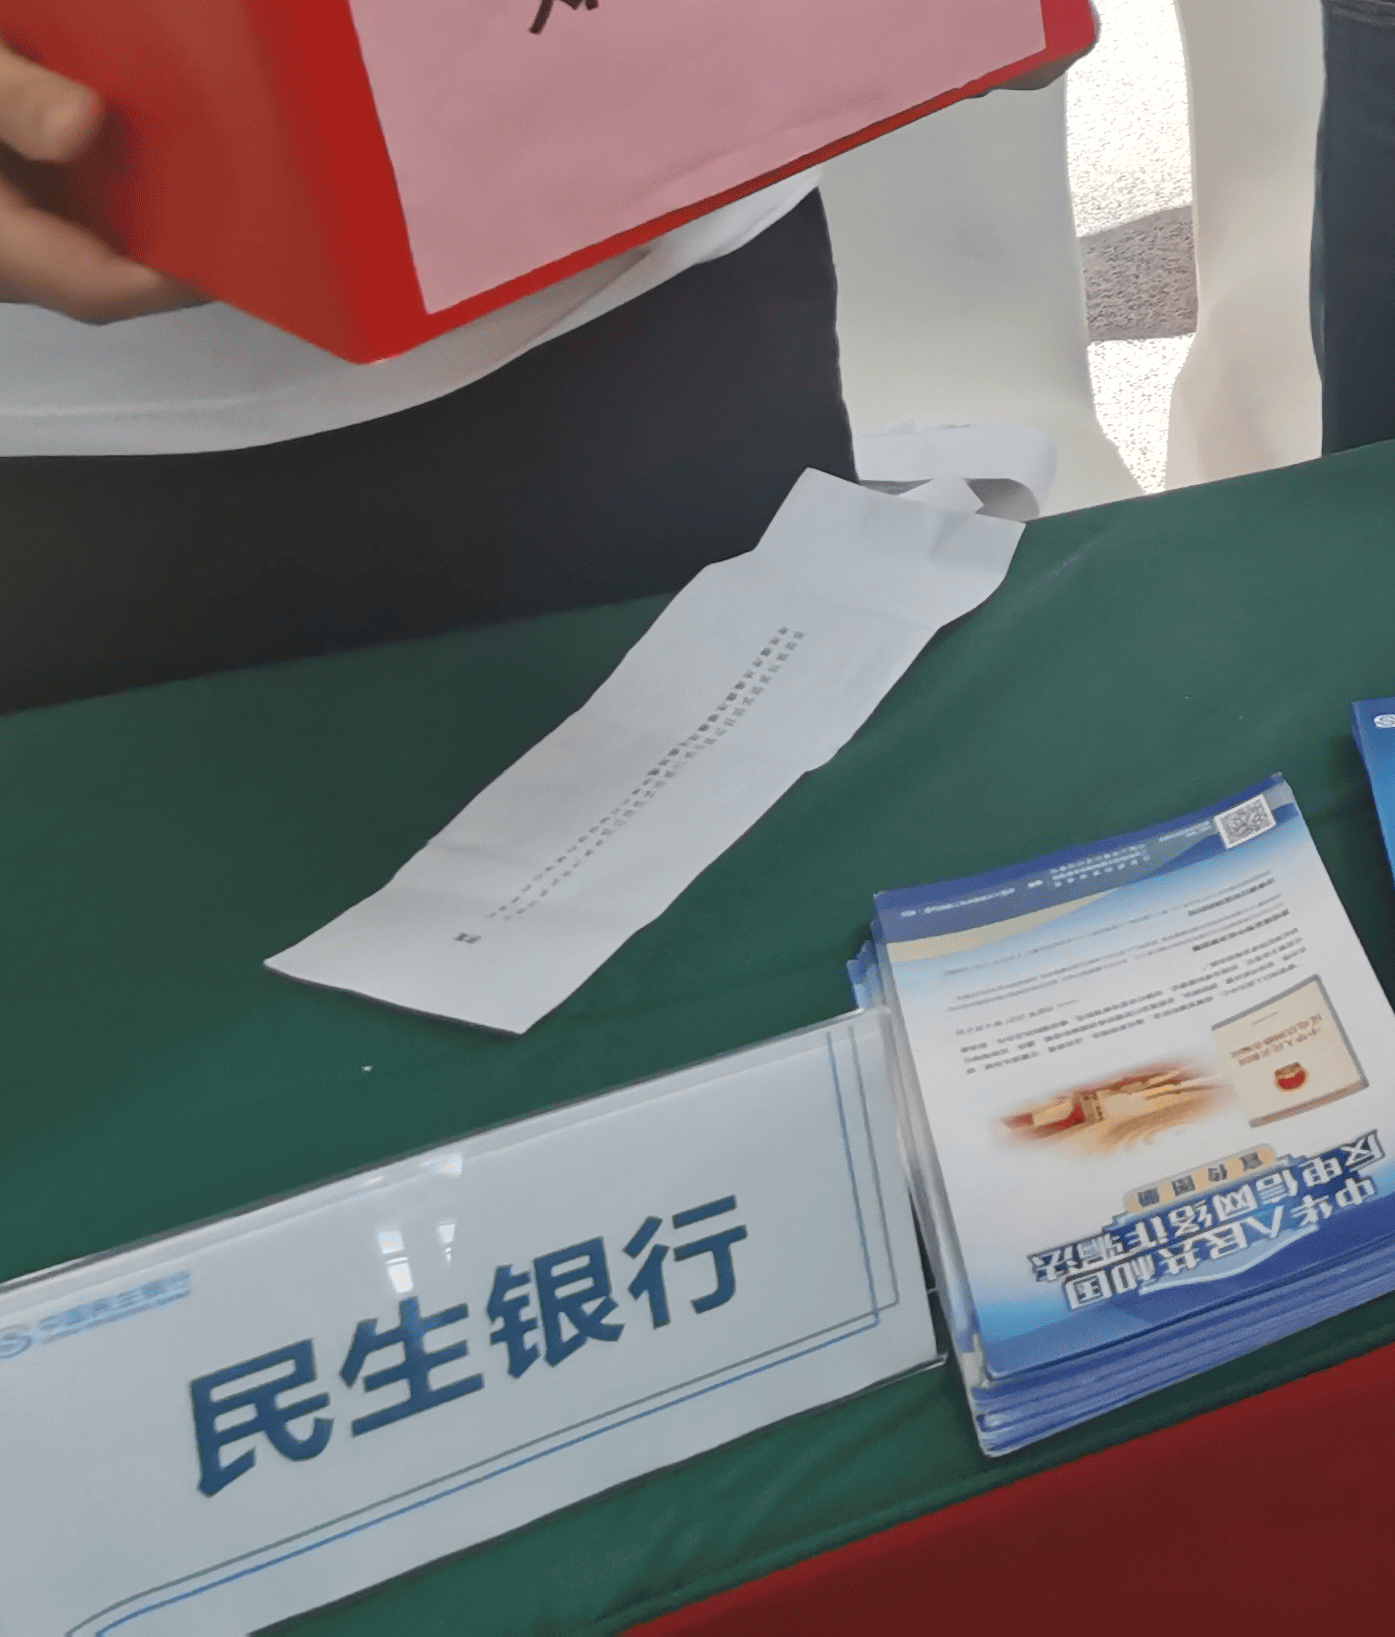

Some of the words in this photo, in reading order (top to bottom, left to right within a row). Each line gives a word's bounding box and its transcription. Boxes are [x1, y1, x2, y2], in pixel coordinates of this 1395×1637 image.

[1030, 1131, 1383, 1281] 反电信网络诈骗法
[1063, 1174, 1376, 1309] 中华人民共和国
[188, 1194, 748, 1497] 民生银行
